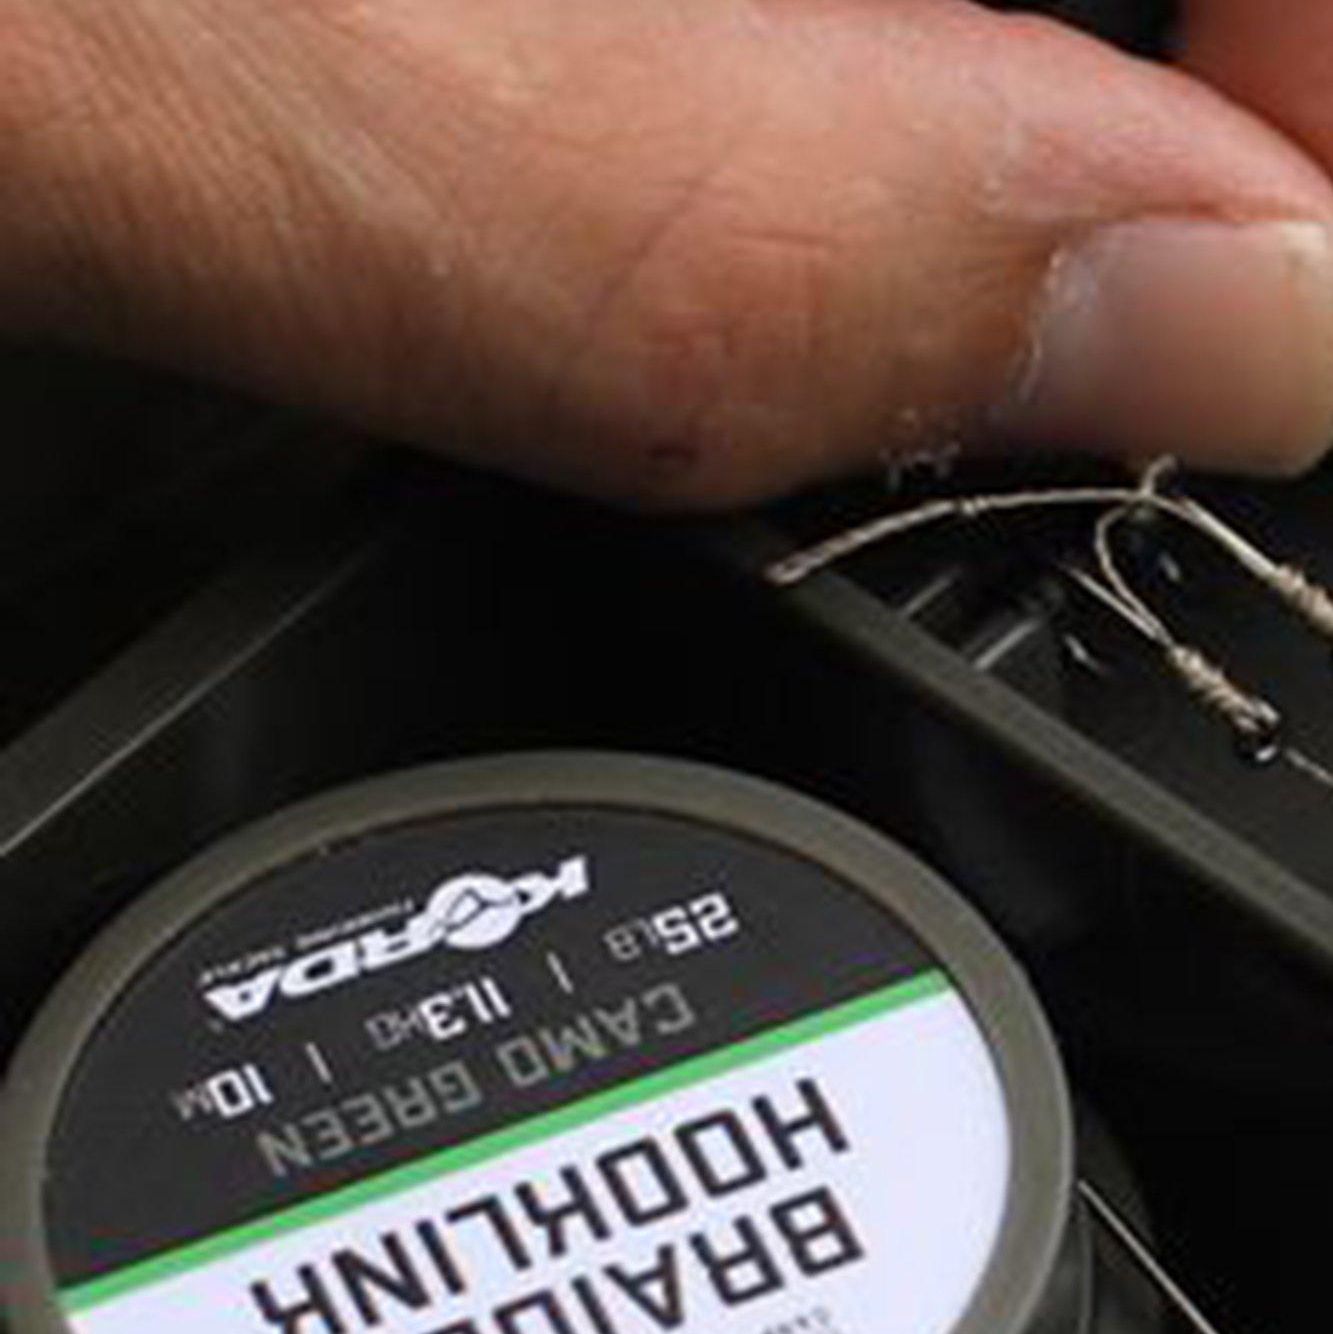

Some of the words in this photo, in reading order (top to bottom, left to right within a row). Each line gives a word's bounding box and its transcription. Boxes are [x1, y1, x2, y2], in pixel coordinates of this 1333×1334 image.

[203, 854, 589, 1021] KORDA
[497, 983, 696, 1087] CAMO
[258, 1059, 482, 1178] GREEN
